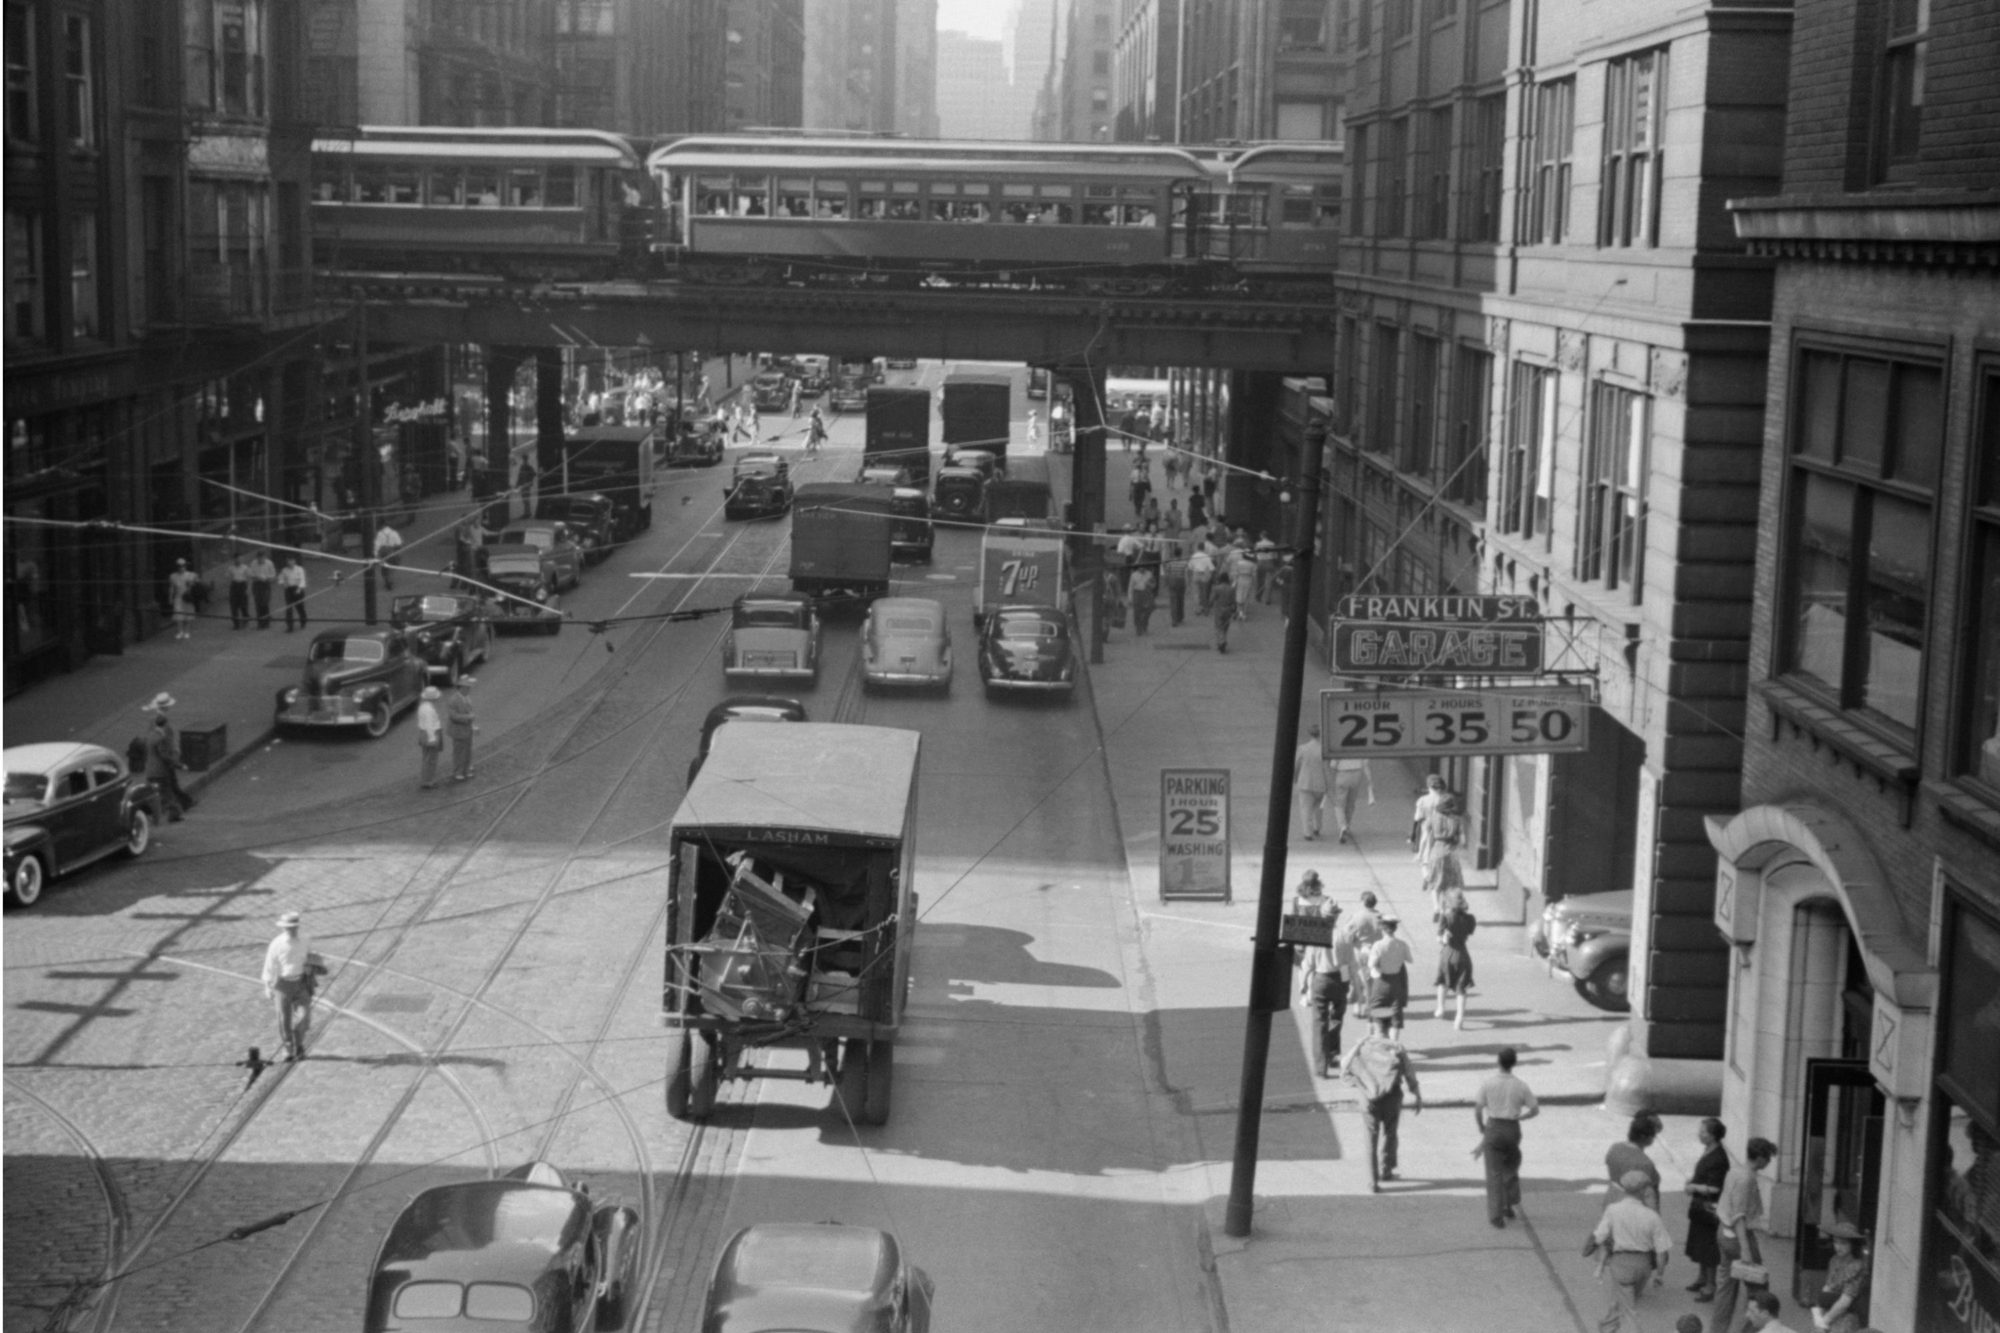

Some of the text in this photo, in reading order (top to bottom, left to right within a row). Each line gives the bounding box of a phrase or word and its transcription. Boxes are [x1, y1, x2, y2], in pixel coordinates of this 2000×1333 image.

[1350, 598, 1531, 617] FRANKLIN ST.
[1351, 630, 1527, 666] GARAGE
[1344, 701, 1391, 712] 1 HOUR
[1429, 700, 1483, 709] 2 HOURS
[1167, 777, 1225, 796] PARKING
[1179, 798, 1218, 807] HOUR
[747, 830, 828, 844] LASHAM
[1167, 843, 1224, 857] WASHING
